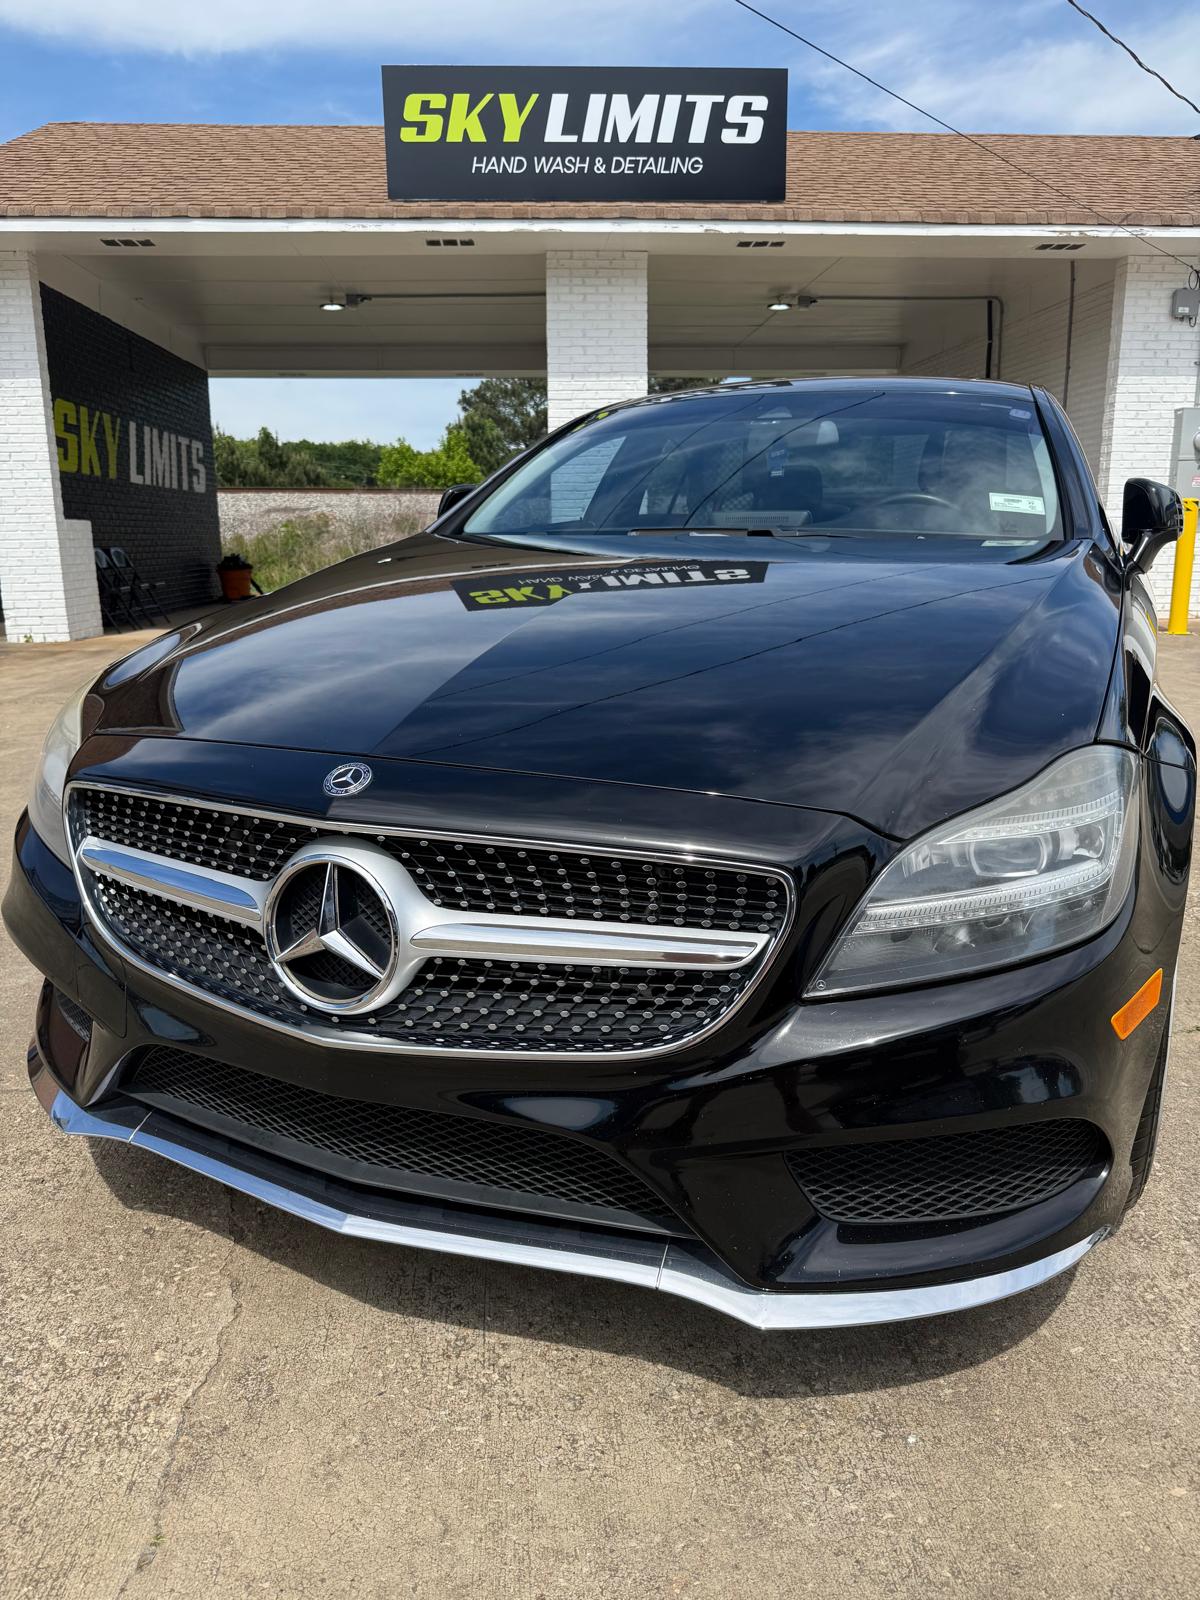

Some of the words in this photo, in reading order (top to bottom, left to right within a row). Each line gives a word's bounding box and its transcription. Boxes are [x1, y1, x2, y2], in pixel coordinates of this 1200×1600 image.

[400, 93, 539, 143] SKY
[544, 93, 769, 144] LIMITS
[472, 157, 527, 174] HAND
[534, 157, 590, 174] WASH
[594, 157, 606, 174] &
[610, 157, 703, 175] DETAILING
[54, 398, 120, 480] SKY
[129, 421, 206, 494] LIMITS
